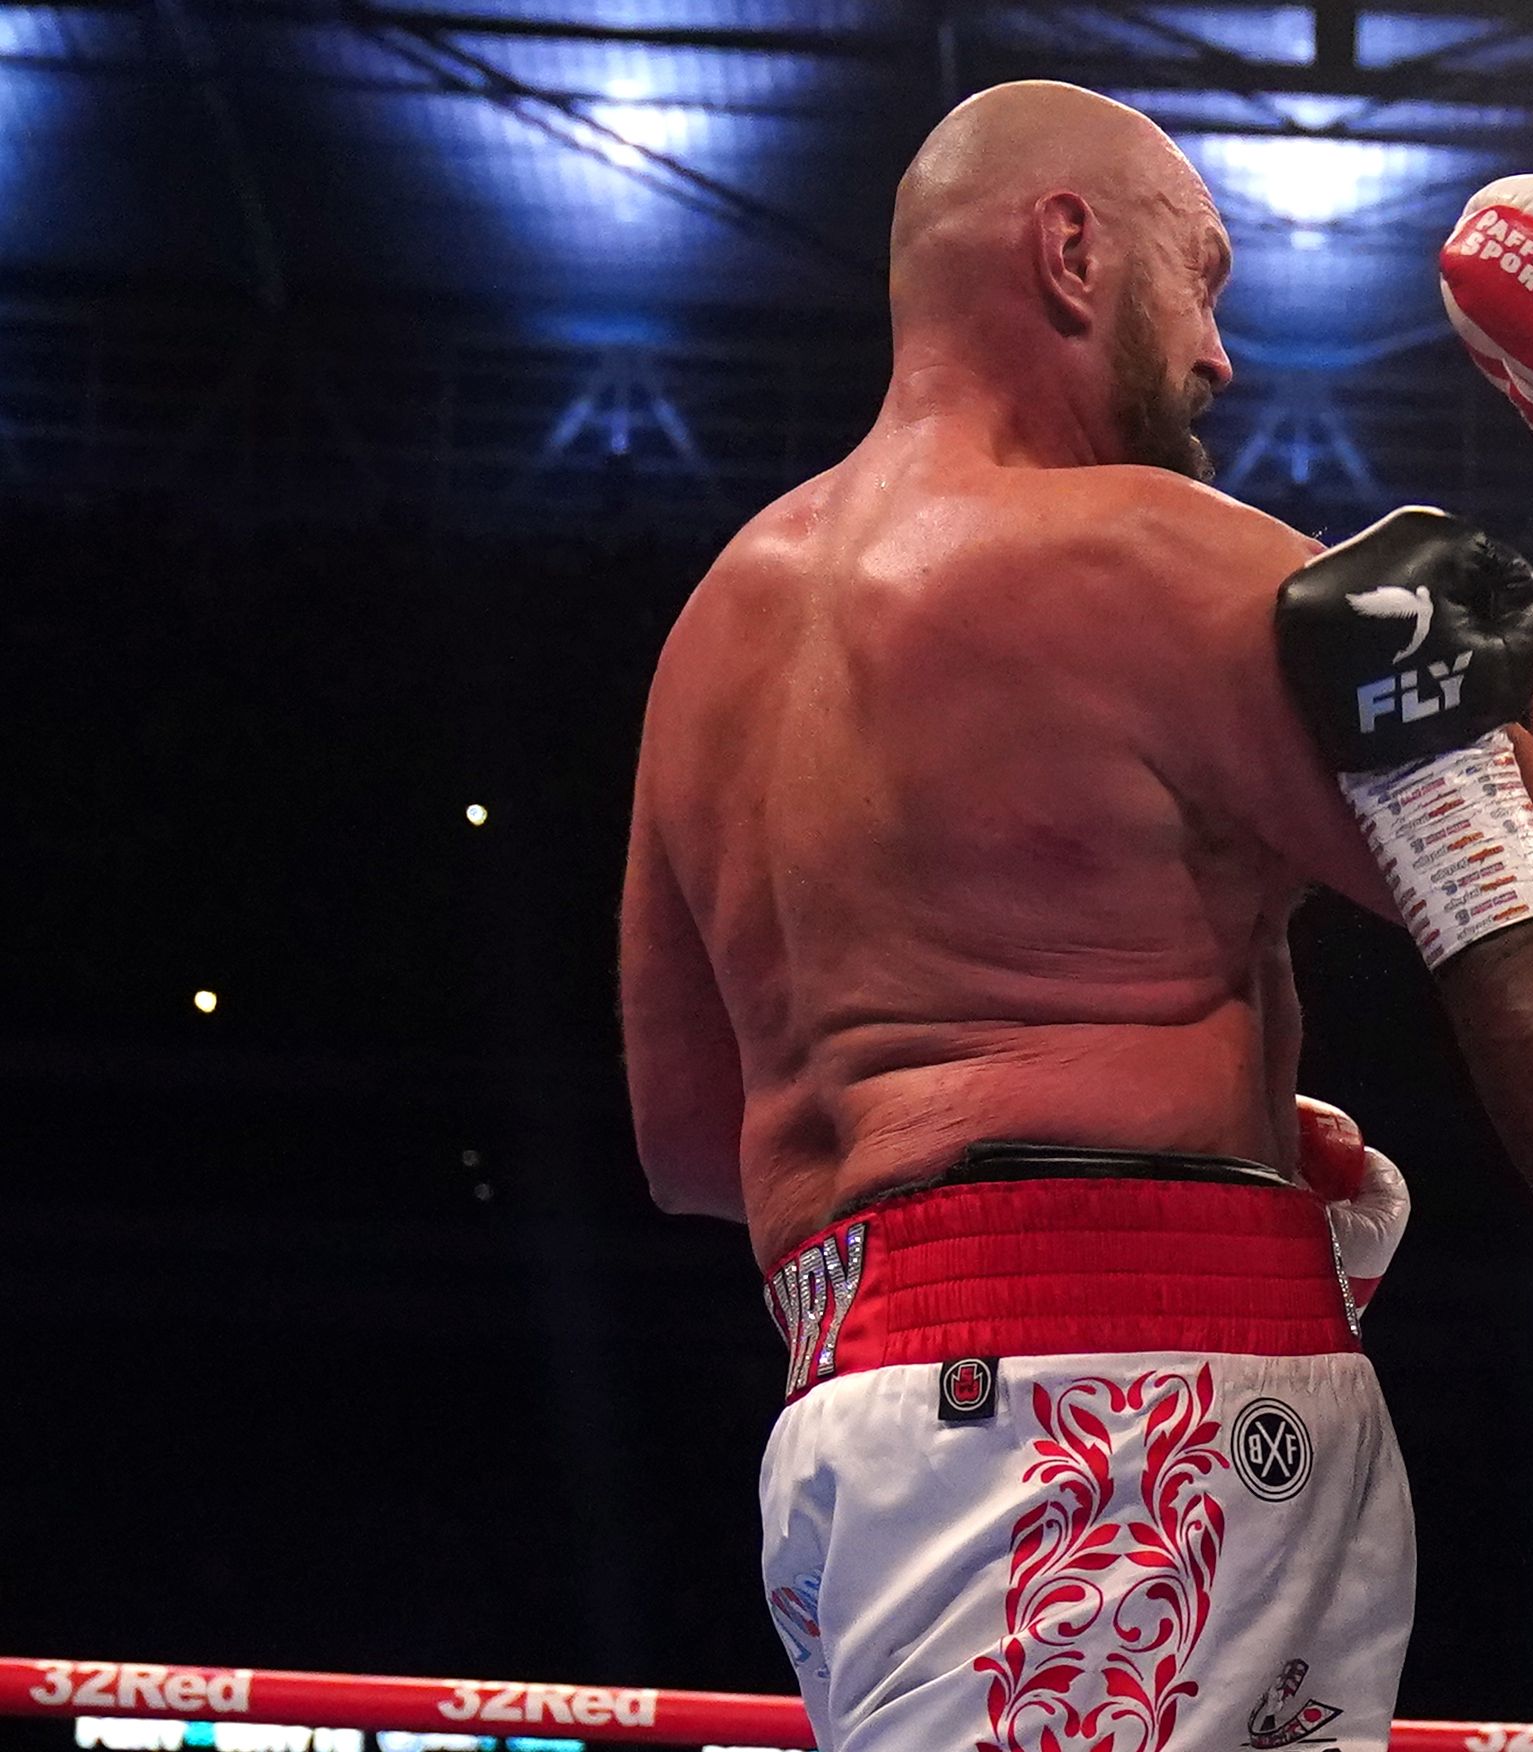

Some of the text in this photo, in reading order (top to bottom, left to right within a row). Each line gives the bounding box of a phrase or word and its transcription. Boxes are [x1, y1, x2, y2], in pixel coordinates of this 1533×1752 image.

[1356, 650, 1474, 734] FLY
[30, 1660, 253, 1713] 32Red
[437, 1678, 658, 1728] 32Red
